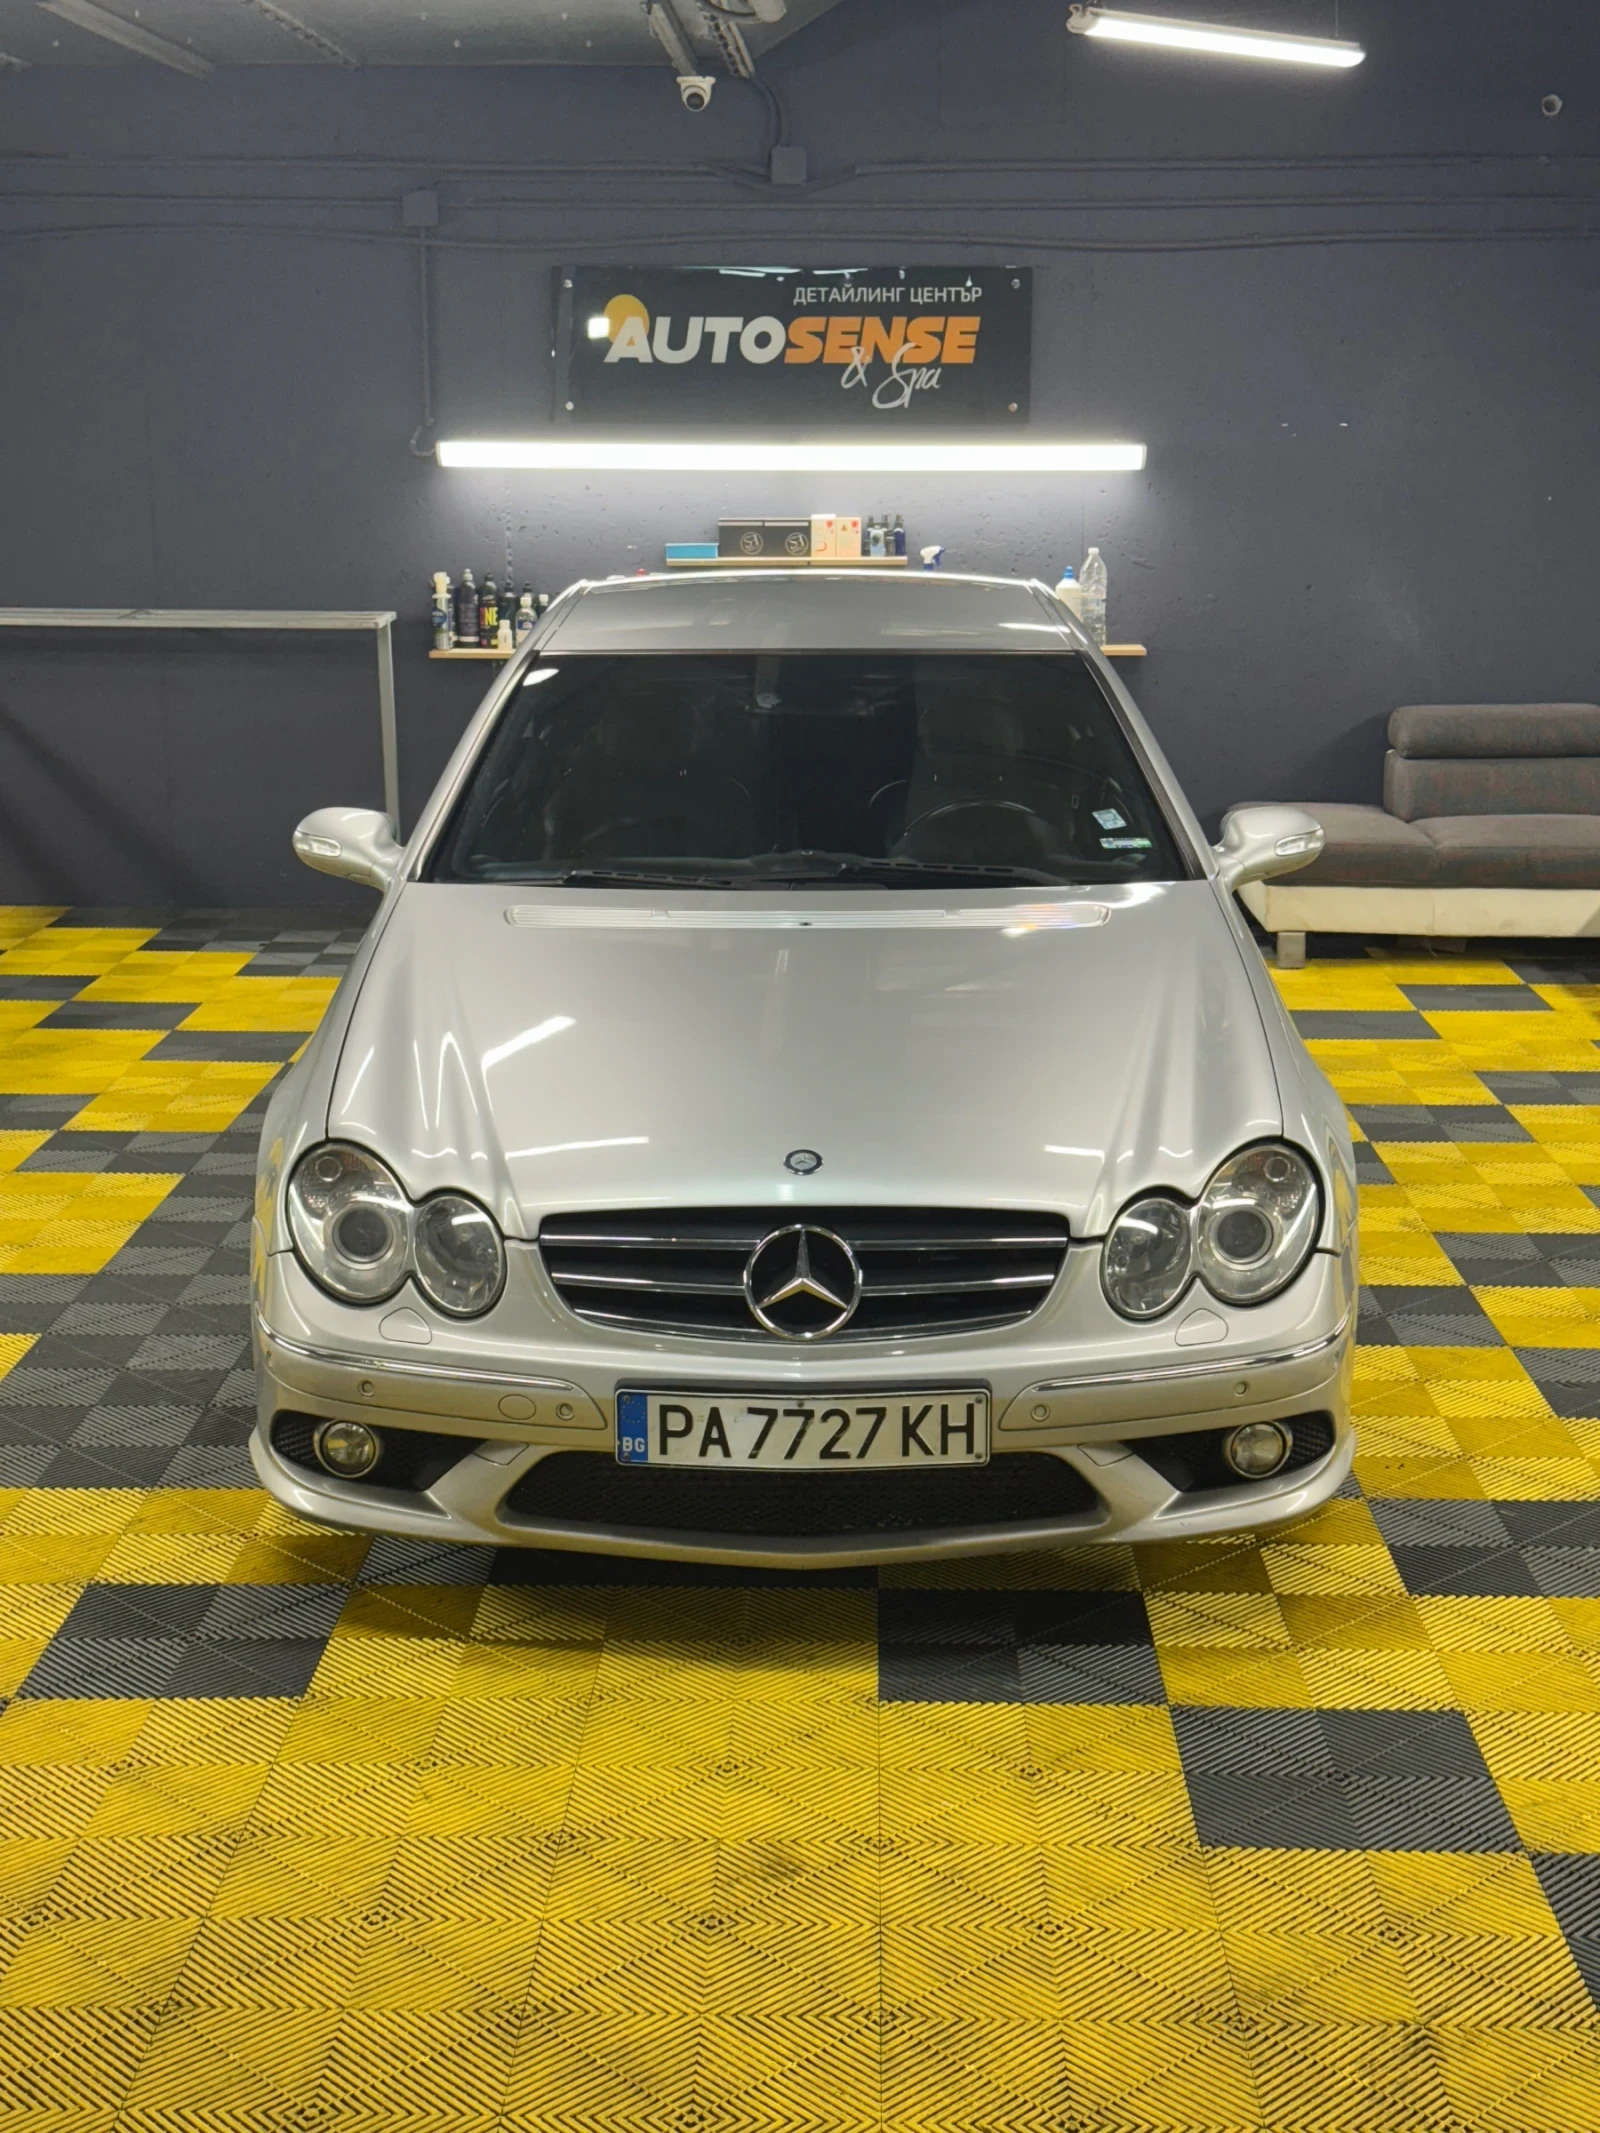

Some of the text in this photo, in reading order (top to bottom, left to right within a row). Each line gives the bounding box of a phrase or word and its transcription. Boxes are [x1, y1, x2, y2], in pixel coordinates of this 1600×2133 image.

[793, 283, 982, 306] ДЕТАЙЛИНГ ЦЕНТЪР
[840, 342, 942, 409] & Spa
[621, 1436, 646, 1453] BG
